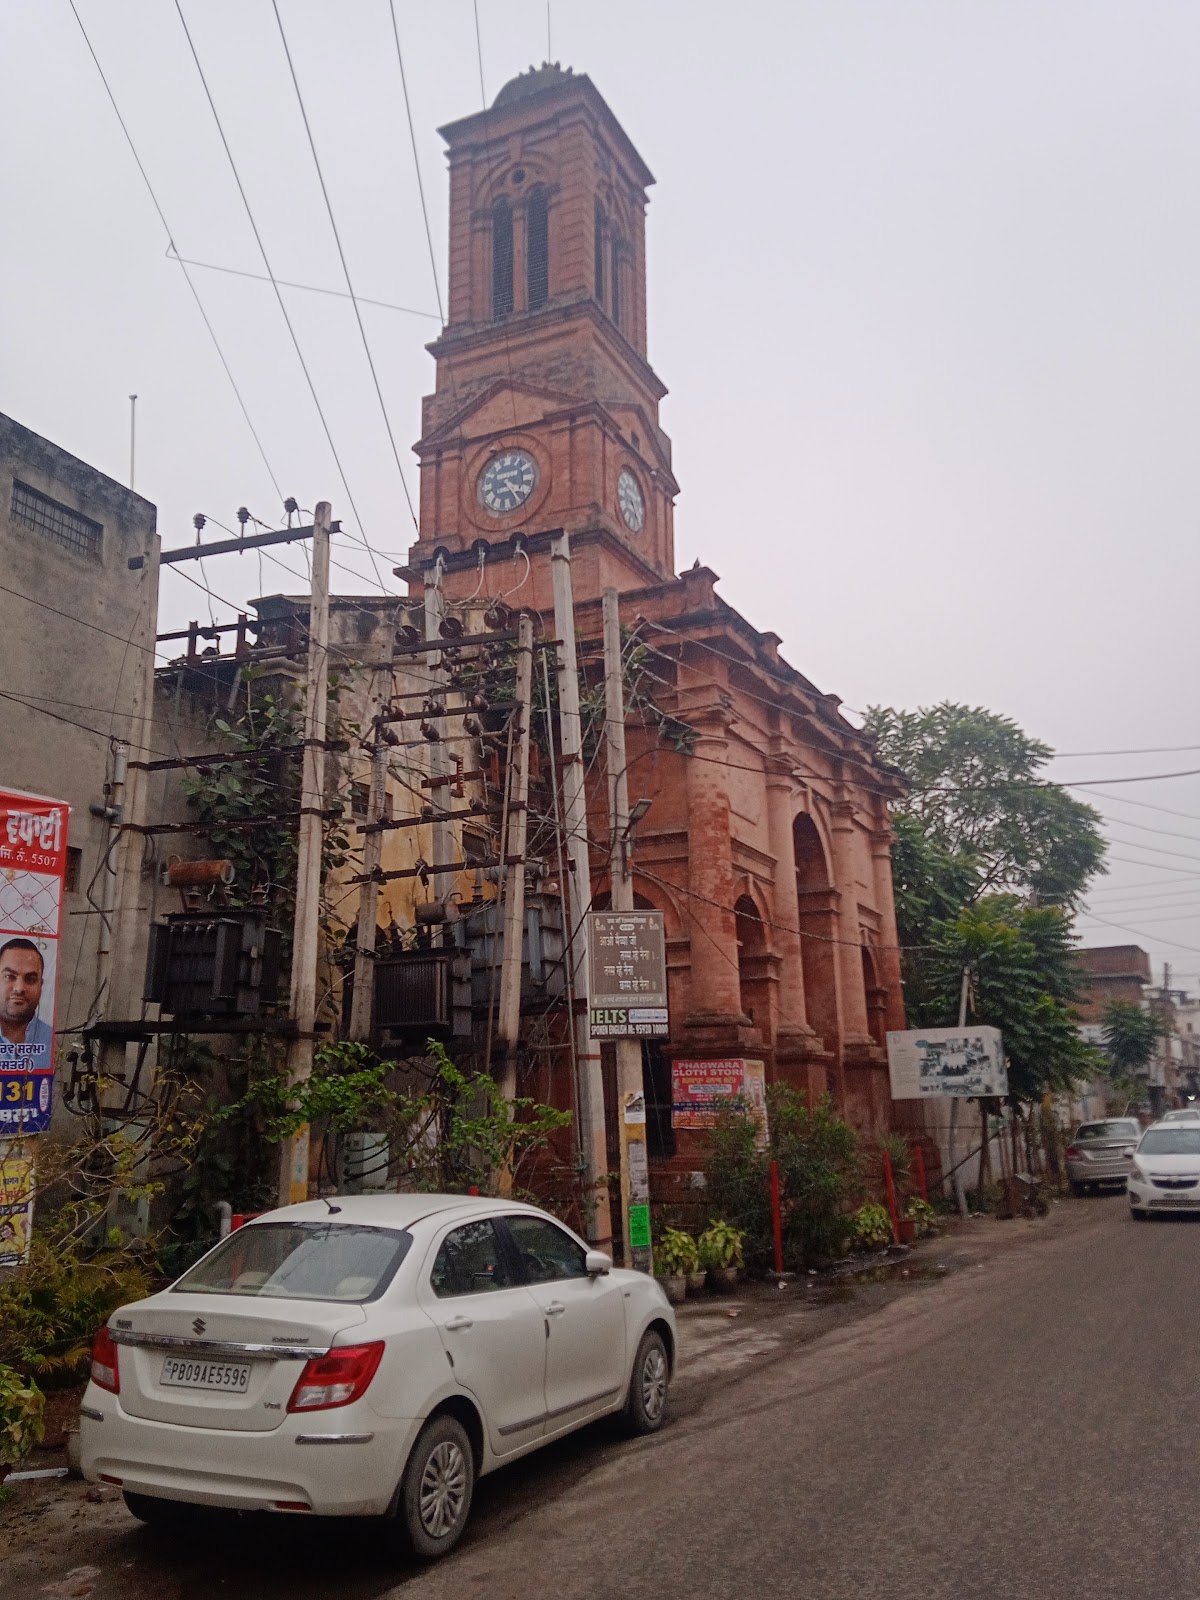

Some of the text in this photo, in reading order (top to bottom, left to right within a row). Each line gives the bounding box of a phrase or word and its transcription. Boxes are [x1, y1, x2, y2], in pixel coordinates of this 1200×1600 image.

[6, 807, 62, 852] ਵਧਾਈ
[31, 853, 57, 867] 5507
[591, 1009, 627, 1024] IELTS
[591, 1024, 609, 1036] SPOKEN
[608, 1024, 628, 1035] ENGLISH
[673, 1069, 707, 1077] CLOTH
[170, 1362, 247, 1386] PB09AE5596
